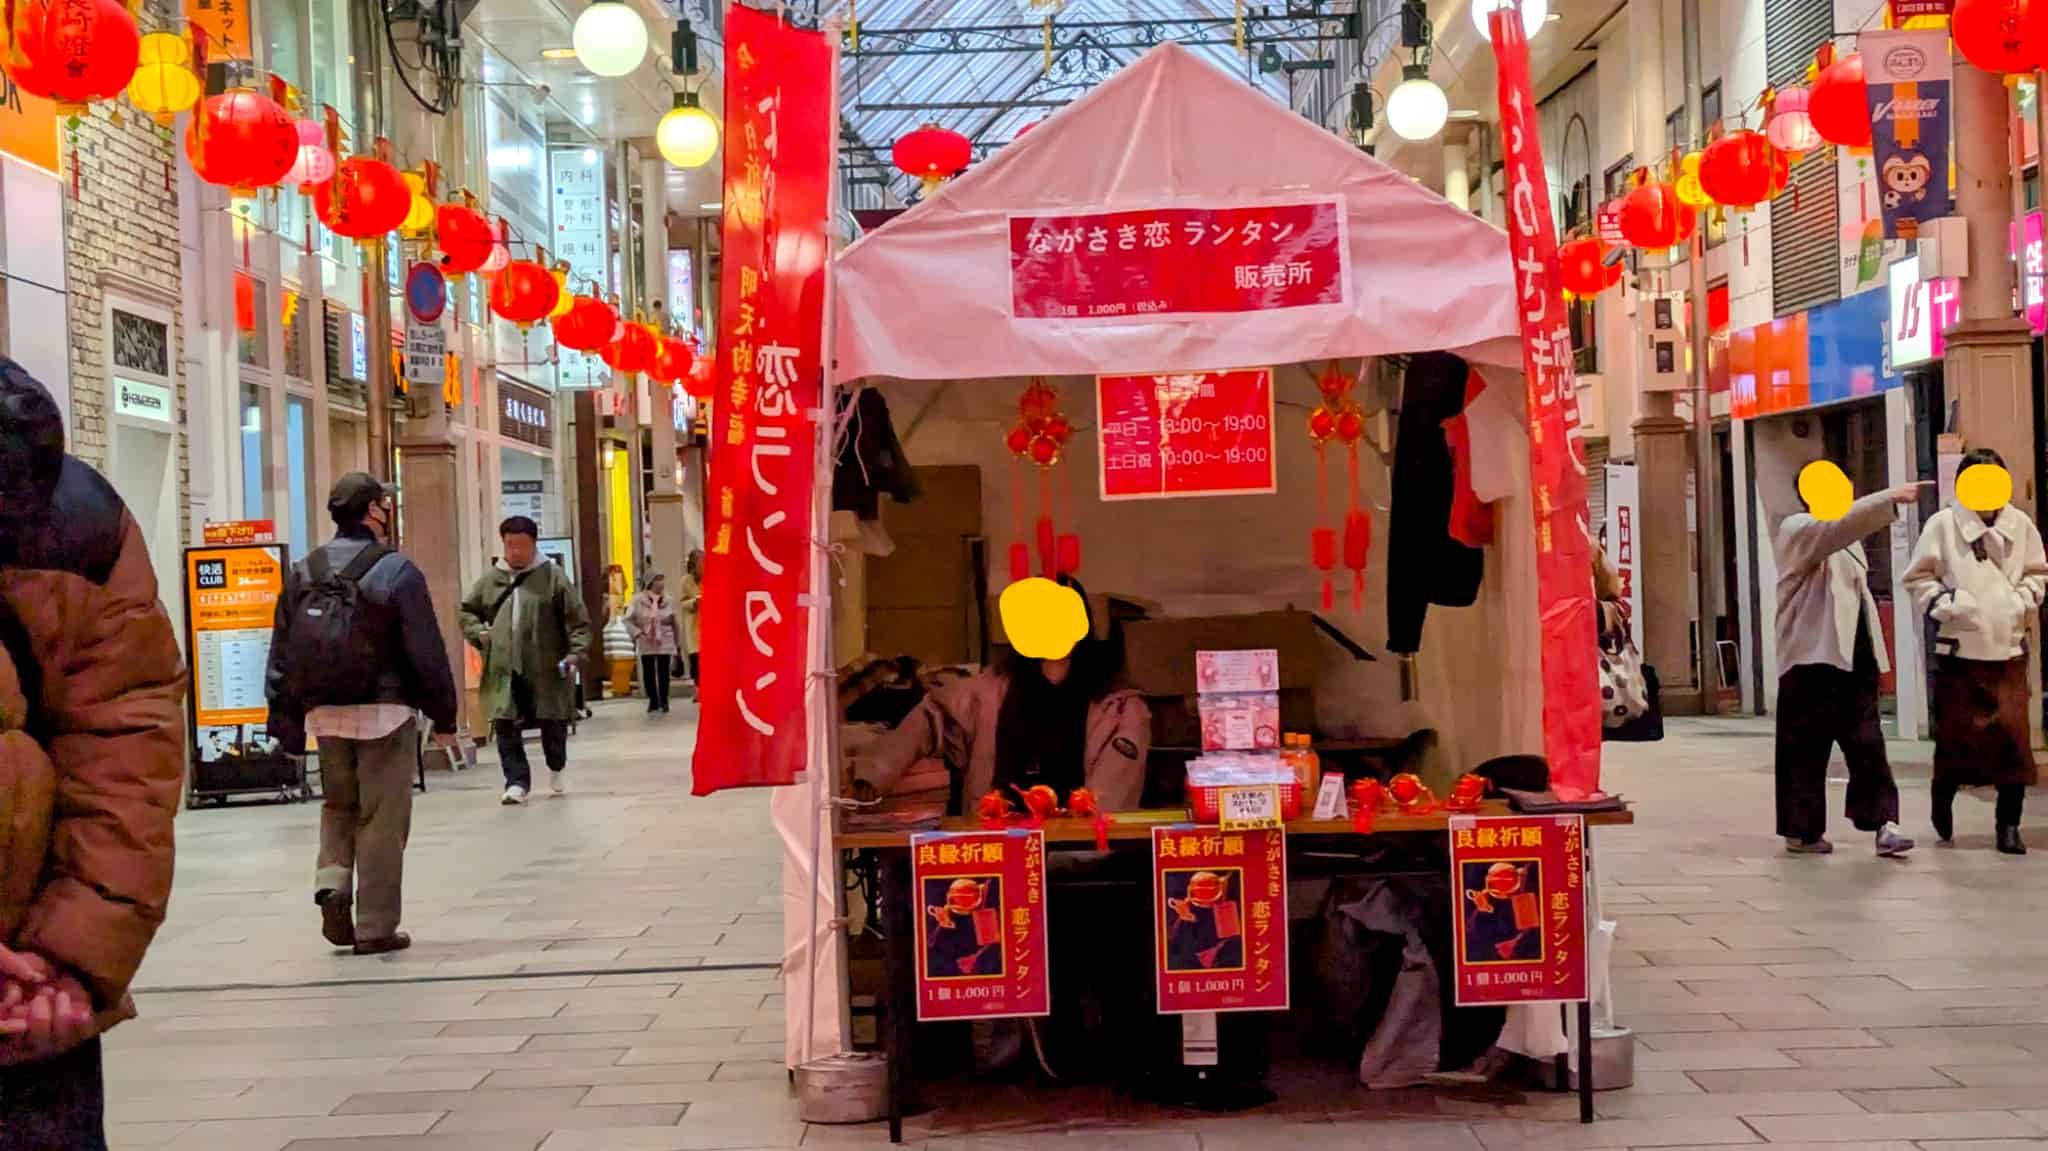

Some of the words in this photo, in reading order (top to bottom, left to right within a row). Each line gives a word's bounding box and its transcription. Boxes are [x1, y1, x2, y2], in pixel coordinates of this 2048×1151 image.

[1027, 220, 1172, 255] ながさき恋
[1183, 218, 1295, 247] ランタン
[1233, 260, 1314, 290] 販売所
[1107, 452, 1153, 470] 土日祝
[199, 576, 224, 585] CLUB
[1011, 907, 1031, 1000] 恋ランタン
[1252, 900, 1272, 993] 恋ランタン
[1551, 891, 1570, 985] 恋ランタン
